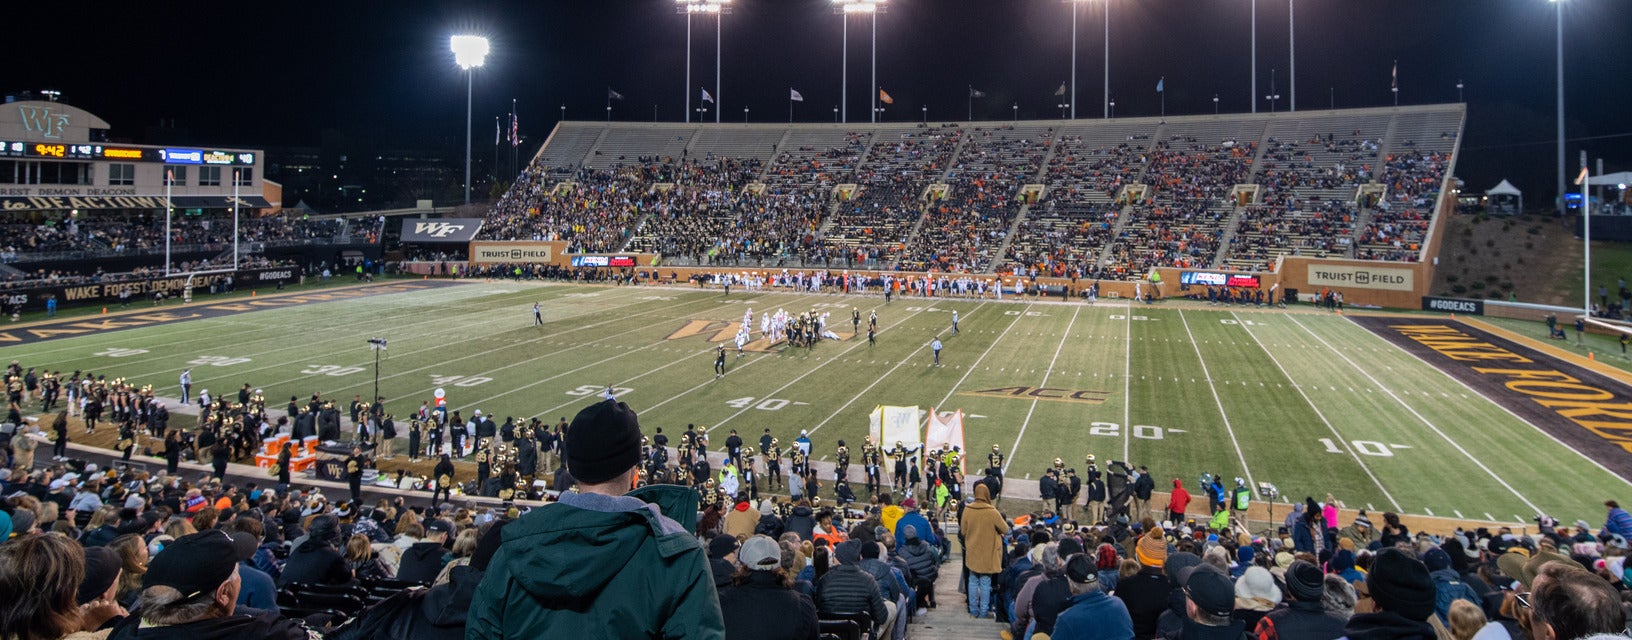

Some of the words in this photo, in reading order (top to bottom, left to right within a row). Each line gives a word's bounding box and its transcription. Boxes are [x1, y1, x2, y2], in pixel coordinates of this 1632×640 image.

[19, 105, 70, 138] WF
[36, 144, 65, 157] 9:42
[38, 188, 80, 196] DEMON
[87, 188, 136, 196] DEACONS
[415, 222, 464, 238] WF
[258, 270, 292, 281] #GODEACS
[1315, 271, 1353, 281] TRUIST
[1372, 274, 1405, 284] FIELD
[65, 285, 100, 301] WAKE
[151, 278, 187, 292] DEMON
[1430, 299, 1476, 312] #GODEACS
[1387, 325, 1535, 363] WAKE
[962, 386, 1118, 403] ACC
[726, 396, 791, 411] 40
[1090, 422, 1163, 440] 20
[1317, 438, 1394, 457] 10
[327, 463, 343, 479] WF
